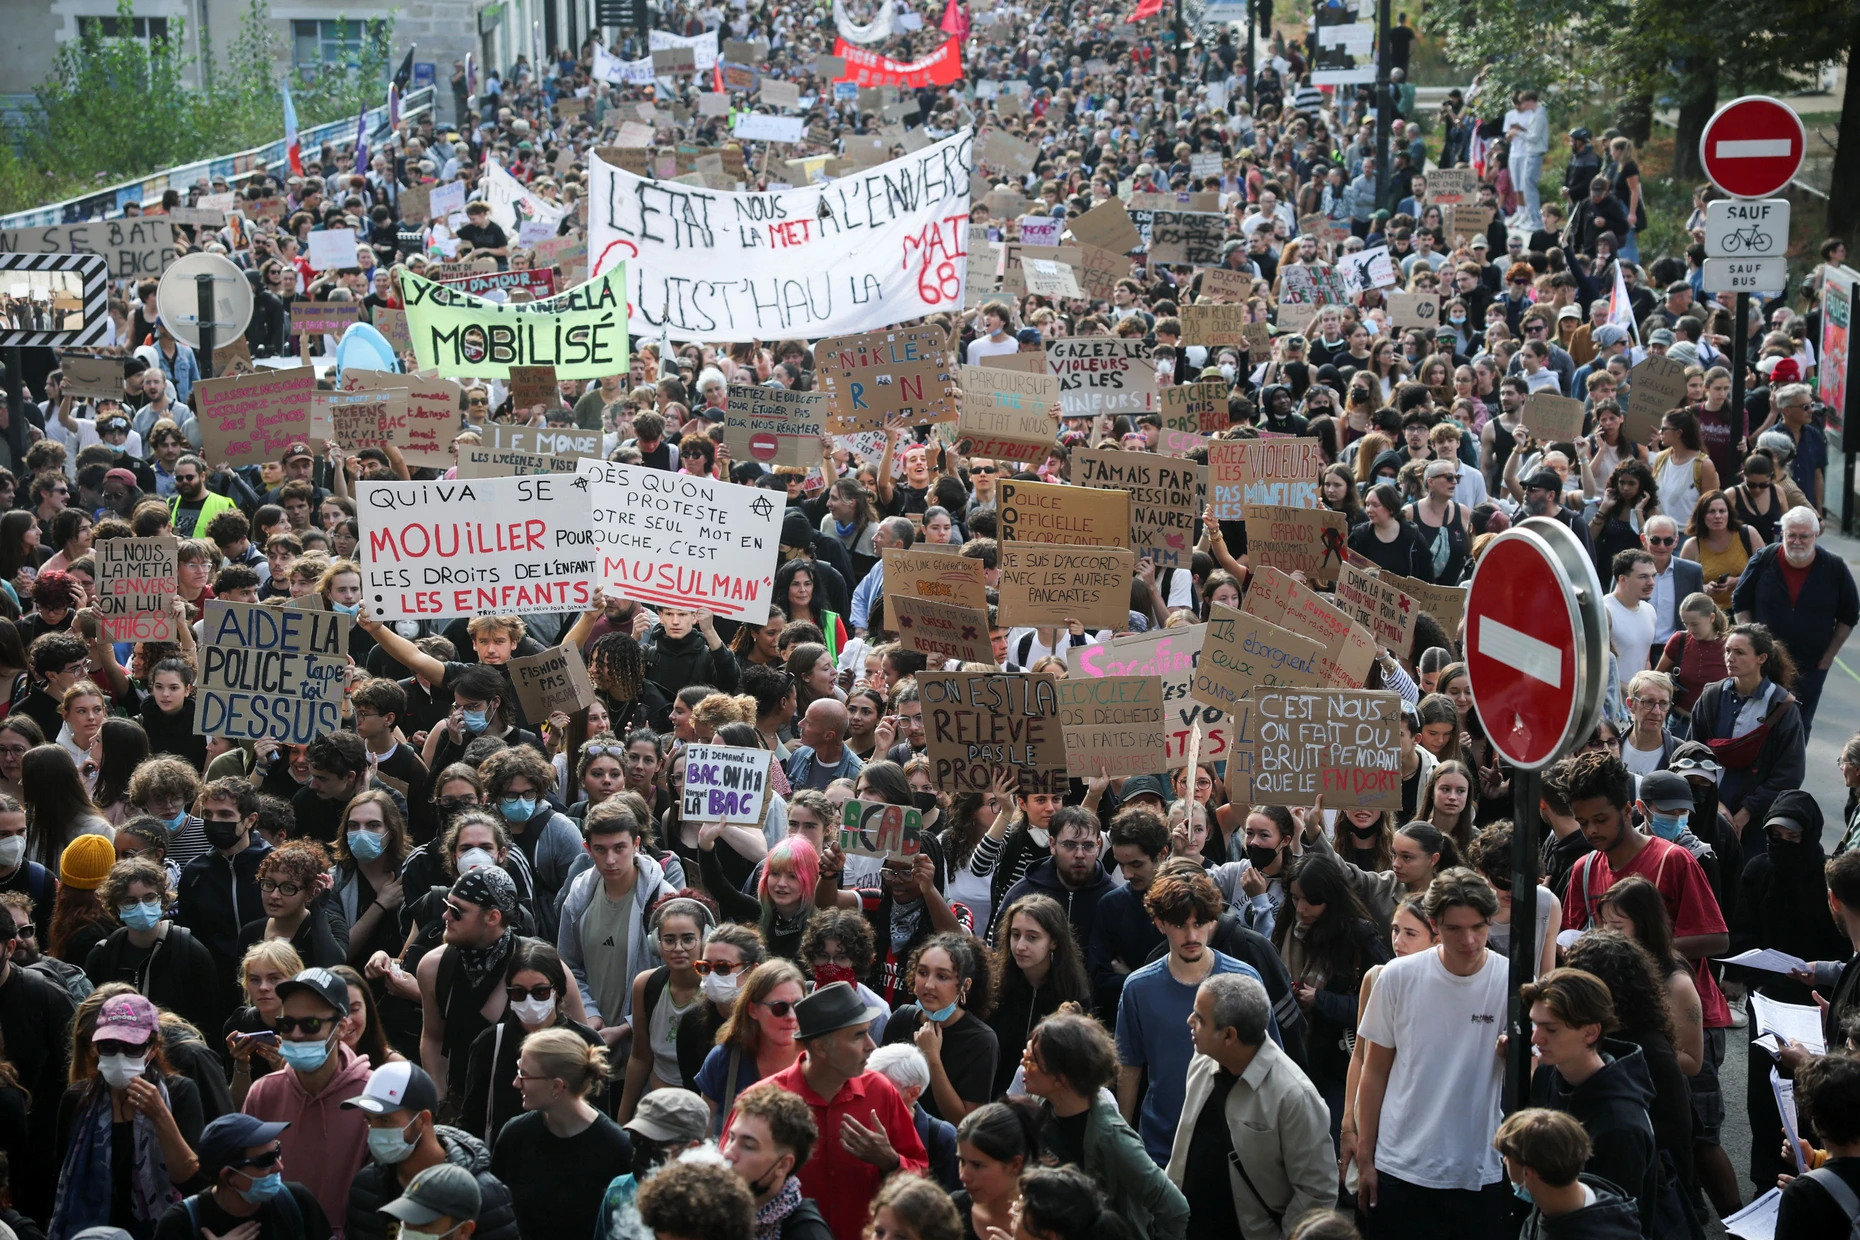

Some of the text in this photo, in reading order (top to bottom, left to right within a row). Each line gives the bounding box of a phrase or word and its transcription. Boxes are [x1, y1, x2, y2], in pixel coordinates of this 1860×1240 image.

[734, 194, 788, 221] NOUS
[1727, 206, 1771, 220] SAUF
[107, 220, 165, 246] BAT
[740, 218, 816, 250] LA MET
[902, 213, 969, 270] MAI
[441, 264, 460, 272] TANT
[1729, 264, 1762, 274] SAUF
[850, 273, 883, 305] LA
[917, 261, 961, 305] 68
[1732, 276, 1757, 287] BUS
[1205, 333, 1240, 345] CHIENS
[890, 341, 919, 364] LE
[1054, 343, 1152, 360] GAZEZ LES
[1646, 356, 1681, 378] RIP
[969, 369, 1052, 397] PARCOURSUP
[1089, 370, 1124, 390] LES
[727, 385, 765, 400] METTEZ
[784, 392, 822, 405] BUDGET
[850, 373, 924, 410] R N
[727, 400, 749, 412] POUR
[219, 416, 247, 432] des
[377, 414, 407, 431] BAC
[727, 416, 775, 431] POUR NOUS
[1018, 416, 1050, 436] NOUS
[1167, 413, 1199, 433] PAS
[249, 428, 272, 441] et
[361, 430, 394, 440] VISE
[535, 431, 598, 455] MONDE
[224, 440, 253, 457] des
[471, 451, 489, 463] LES
[1208, 444, 1247, 465] GAZEZ
[514, 465, 528, 476] LE
[1158, 468, 1193, 491] PAR
[1217, 465, 1242, 481] LES
[517, 480, 555, 502] SE
[587, 461, 714, 502] DÈS QU'ON
[1215, 484, 1241, 502] PAS
[626, 491, 728, 525] PROTESTE
[1135, 506, 1193, 529] N'AUREZ
[1214, 503, 1243, 519] LES
[1249, 506, 1299, 522] ILS SONT
[555, 529, 595, 548] POUR
[643, 515, 763, 550] SEUL MOT EN
[1270, 523, 1314, 544] GRANDS
[669, 540, 718, 560] C'EST
[1140, 547, 1179, 566] NTM
[895, 559, 915, 573] PAS
[916, 560, 931, 572] UNE
[1003, 552, 1121, 571] JE D'ACCORD
[1273, 552, 1320, 572] GENOUX
[100, 576, 177, 597] L'ENVERS
[370, 568, 412, 588] LES
[1003, 569, 1122, 588] AVEC LES AUTRES
[1347, 570, 1395, 606] DANS LA RUE
[1383, 574, 1420, 595] RENDEZ
[1444, 593, 1459, 603] LES
[102, 595, 126, 615] ON
[400, 580, 590, 615] LES ENFANTS
[1027, 587, 1101, 603] PANCARTES
[1250, 581, 1308, 625] pas toujours
[1265, 568, 1350, 639] Si jeunesse
[1337, 582, 1409, 629] AUJOURD'HUI POUR NE
[215, 607, 341, 655] AIDE LA
[922, 615, 956, 631] BAISER
[1210, 618, 1236, 643] Ils
[1336, 598, 1347, 614] PAS
[1373, 617, 1404, 644] DEMAIN
[913, 637, 959, 658] REVISER
[1242, 629, 1317, 675] éborgnent
[202, 648, 345, 696] POLICE tape
[519, 655, 568, 681] FASHION
[1211, 649, 1255, 676] ceux
[299, 680, 324, 701] toi
[540, 674, 567, 692] PAS
[923, 673, 1058, 717] ON EST LA
[1093, 705, 1160, 726] DÉCHETS
[1259, 693, 1388, 721] C'EST NOUS
[200, 691, 338, 745] DESSUS
[933, 706, 1047, 747] RELÈVE
[1138, 731, 1166, 749] PAS
[1260, 721, 1391, 749] ON DU
[711, 750, 756, 765] DEMANDÉ LE
[967, 744, 1038, 767] PAS LE
[1329, 744, 1401, 771] PENDANT
[723, 764, 743, 790] ON
[1255, 768, 1399, 796] QUE LE DORT
[684, 788, 754, 817] LA BAC
[839, 800, 923, 857] ACAB
